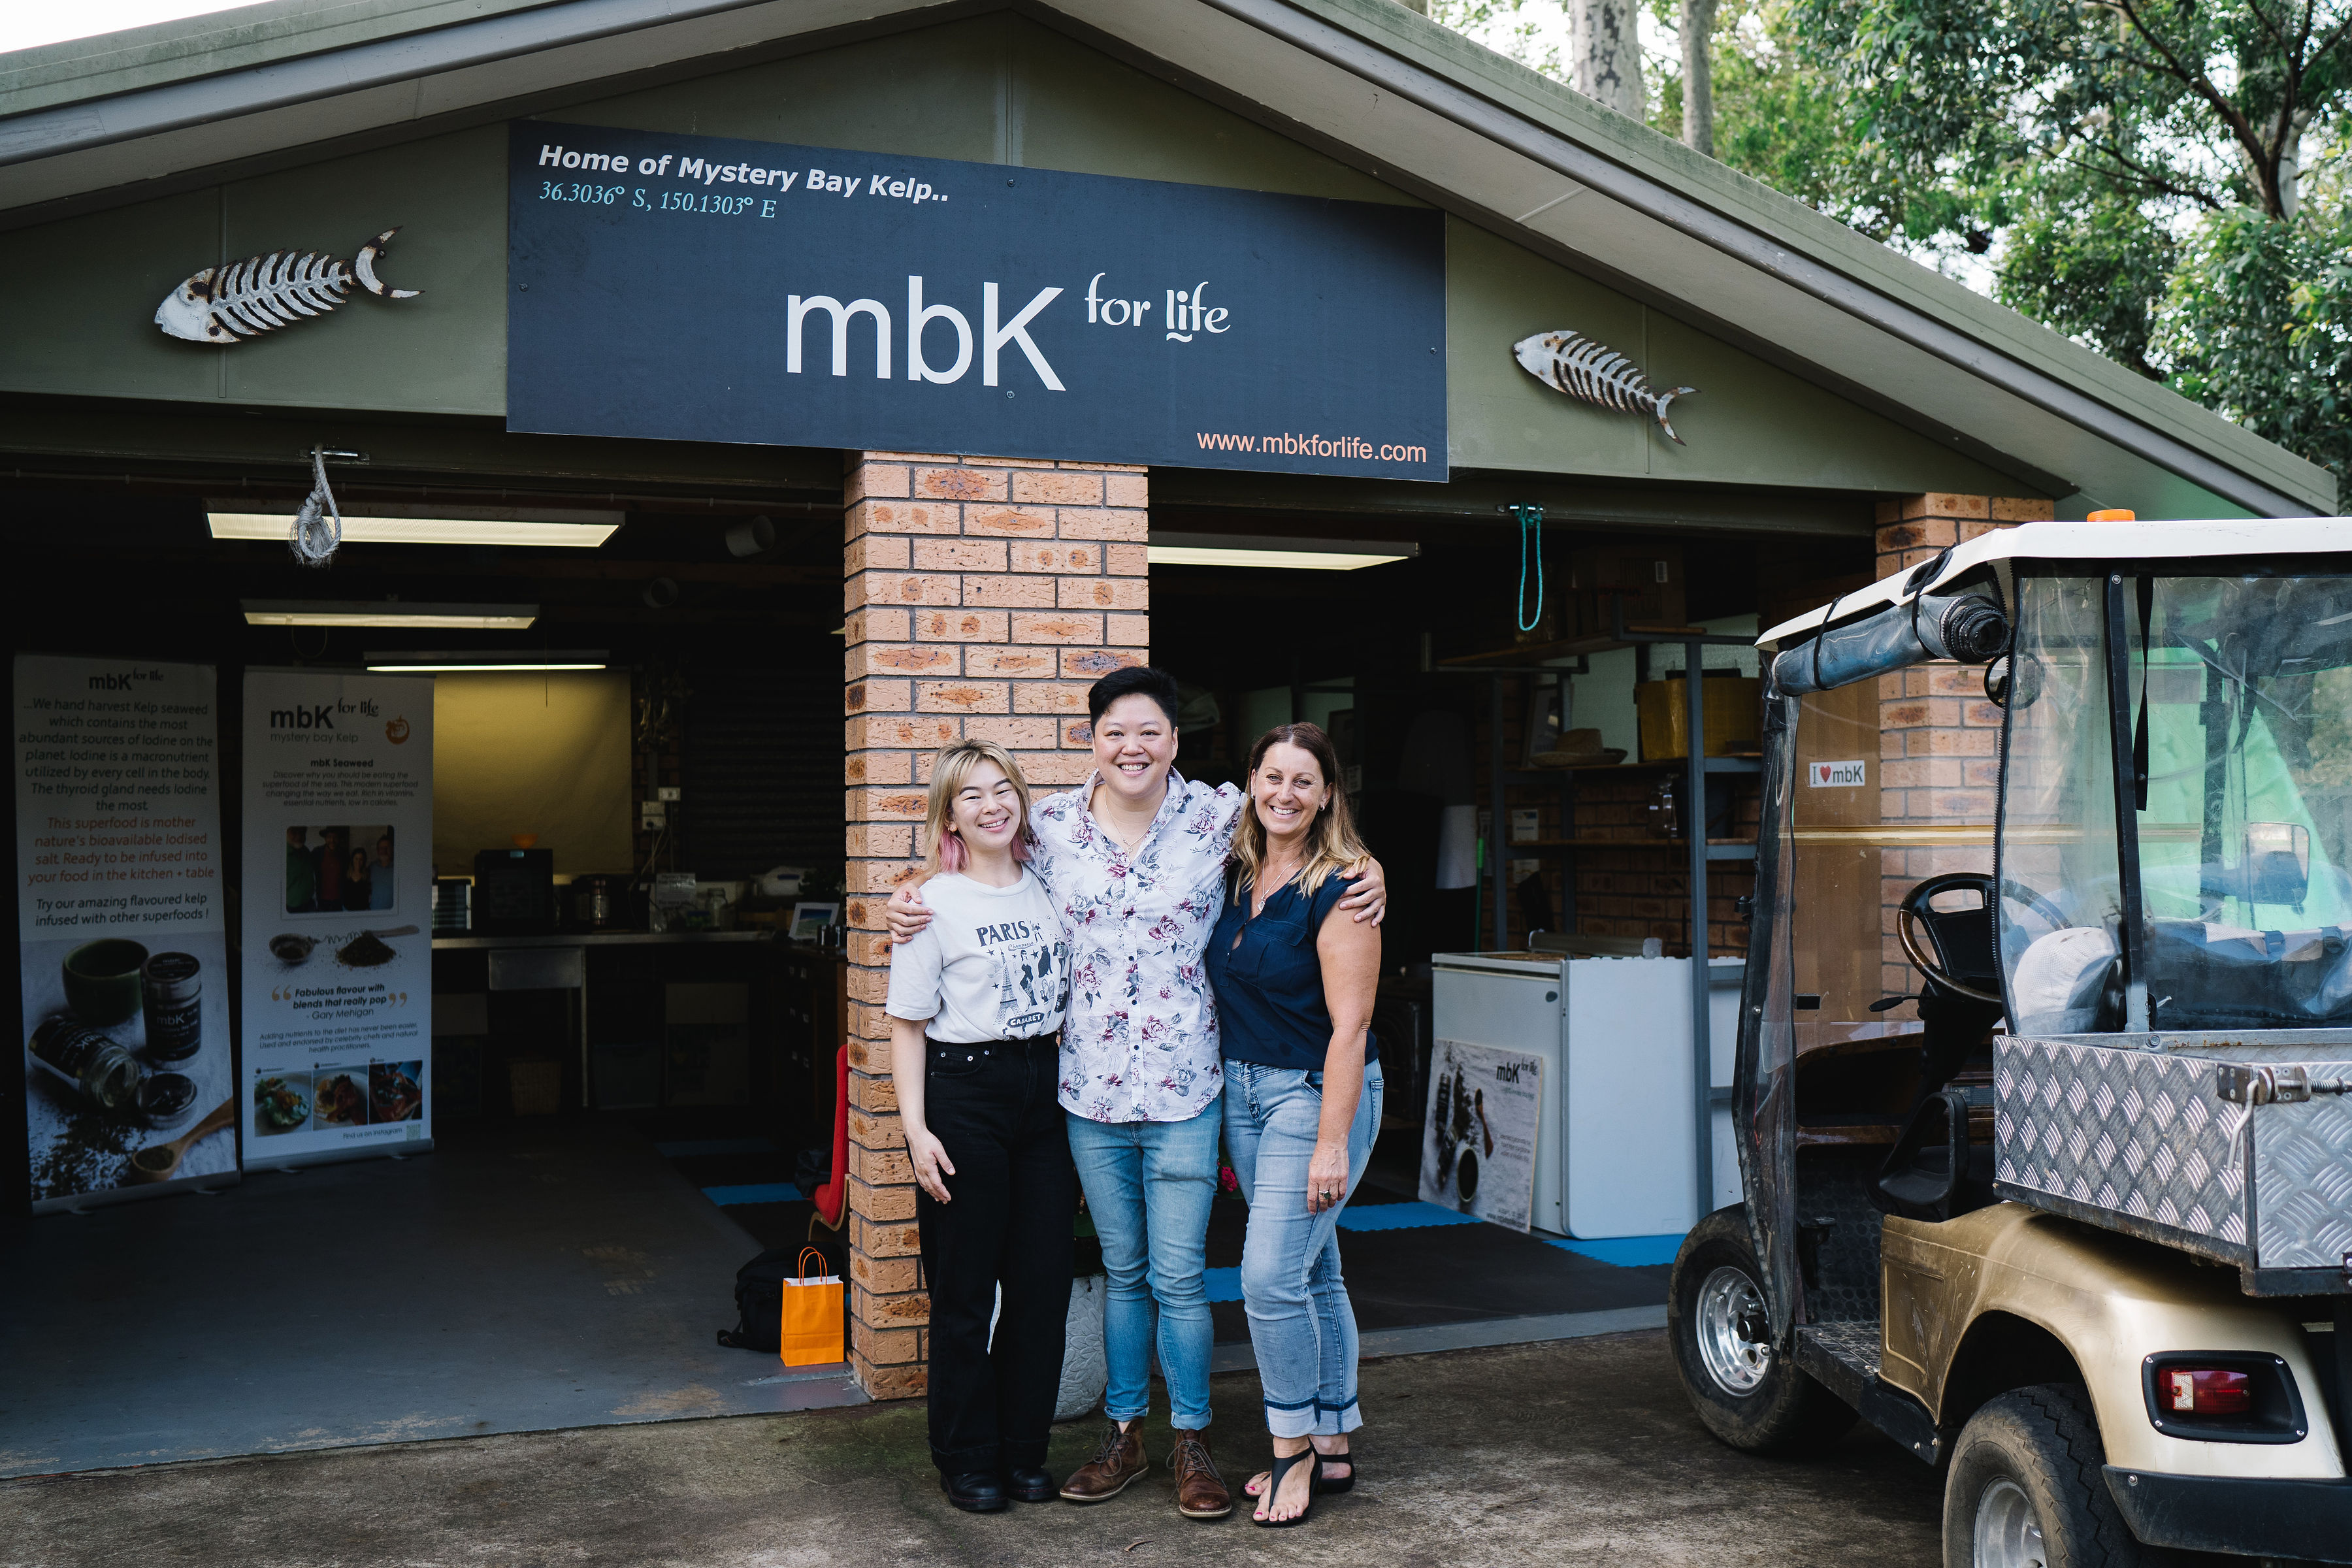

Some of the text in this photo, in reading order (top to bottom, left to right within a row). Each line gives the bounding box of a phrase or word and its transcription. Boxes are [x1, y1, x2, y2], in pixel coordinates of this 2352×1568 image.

[539, 144, 948, 203] Home of Mystery Bay Kelp..
[539, 182, 777, 218] 36.3036° S, 150.1303° E
[787, 272, 1231, 391] mbK for life
[1197, 433, 1426, 463] www.mbkforlife.com
[89, 668, 163, 690] mbK for life
[55, 699, 84, 710] hand
[88, 700, 130, 711] harvest
[133, 701, 158, 714] Kelp
[161, 704, 208, 715] seaweed
[270, 697, 380, 729] mbK for life
[50, 716, 188, 730] which contains the most
[19, 732, 78, 743] abundant
[82, 736, 124, 745] sources
[128, 733, 140, 745] of
[180, 737, 193, 746] on
[196, 736, 213, 746] the
[270, 732, 358, 743] mystery bay Kelp
[110, 750, 118, 760] is
[131, 751, 209, 762] macronutrient
[310, 759, 331, 767] mbK
[25, 766, 210, 781] utilized by every cell in the body.
[306, 772, 320, 781] why
[373, 771, 395, 780] eating
[1812, 765, 1863, 783] I mbK
[31, 783, 53, 794] The
[56, 783, 98, 797] thyroid
[102, 783, 135, 797] gland
[137, 784, 170, 794] needs
[266, 789, 300, 798] changing
[96, 800, 115, 810] the
[48, 816, 196, 831] This superfood is mother
[35, 835, 85, 847] nature's
[89, 834, 162, 846] bioavailable
[63, 852, 101, 866] Ready
[104, 853, 116, 864] to
[120, 852, 135, 862] be
[139, 851, 182, 862] infused
[185, 851, 208, 861] into
[27, 873, 56, 886] your
[59, 870, 89, 882] food
[93, 870, 103, 881] in
[107, 869, 126, 881] the
[130, 868, 172, 879] kitchen
[186, 866, 214, 878] table
[37, 892, 206, 912] Try our amazing flavoured kelp
[35, 914, 78, 926] infused
[81, 913, 106, 924] with
[110, 912, 139, 923] other
[142, 908, 203, 923] superfoods
[975, 921, 1030, 947] PARIS
[295, 988, 334, 997] Fabulous
[336, 986, 366, 994] flavour
[293, 1000, 322, 1009] blends
[344, 996, 367, 1006] really
[370, 996, 387, 1005] pop
[312, 1009, 374, 1020] Gary Mehigan
[1010, 1013, 1041, 1026] CABARET
[1496, 1062, 1520, 1084] mbK
